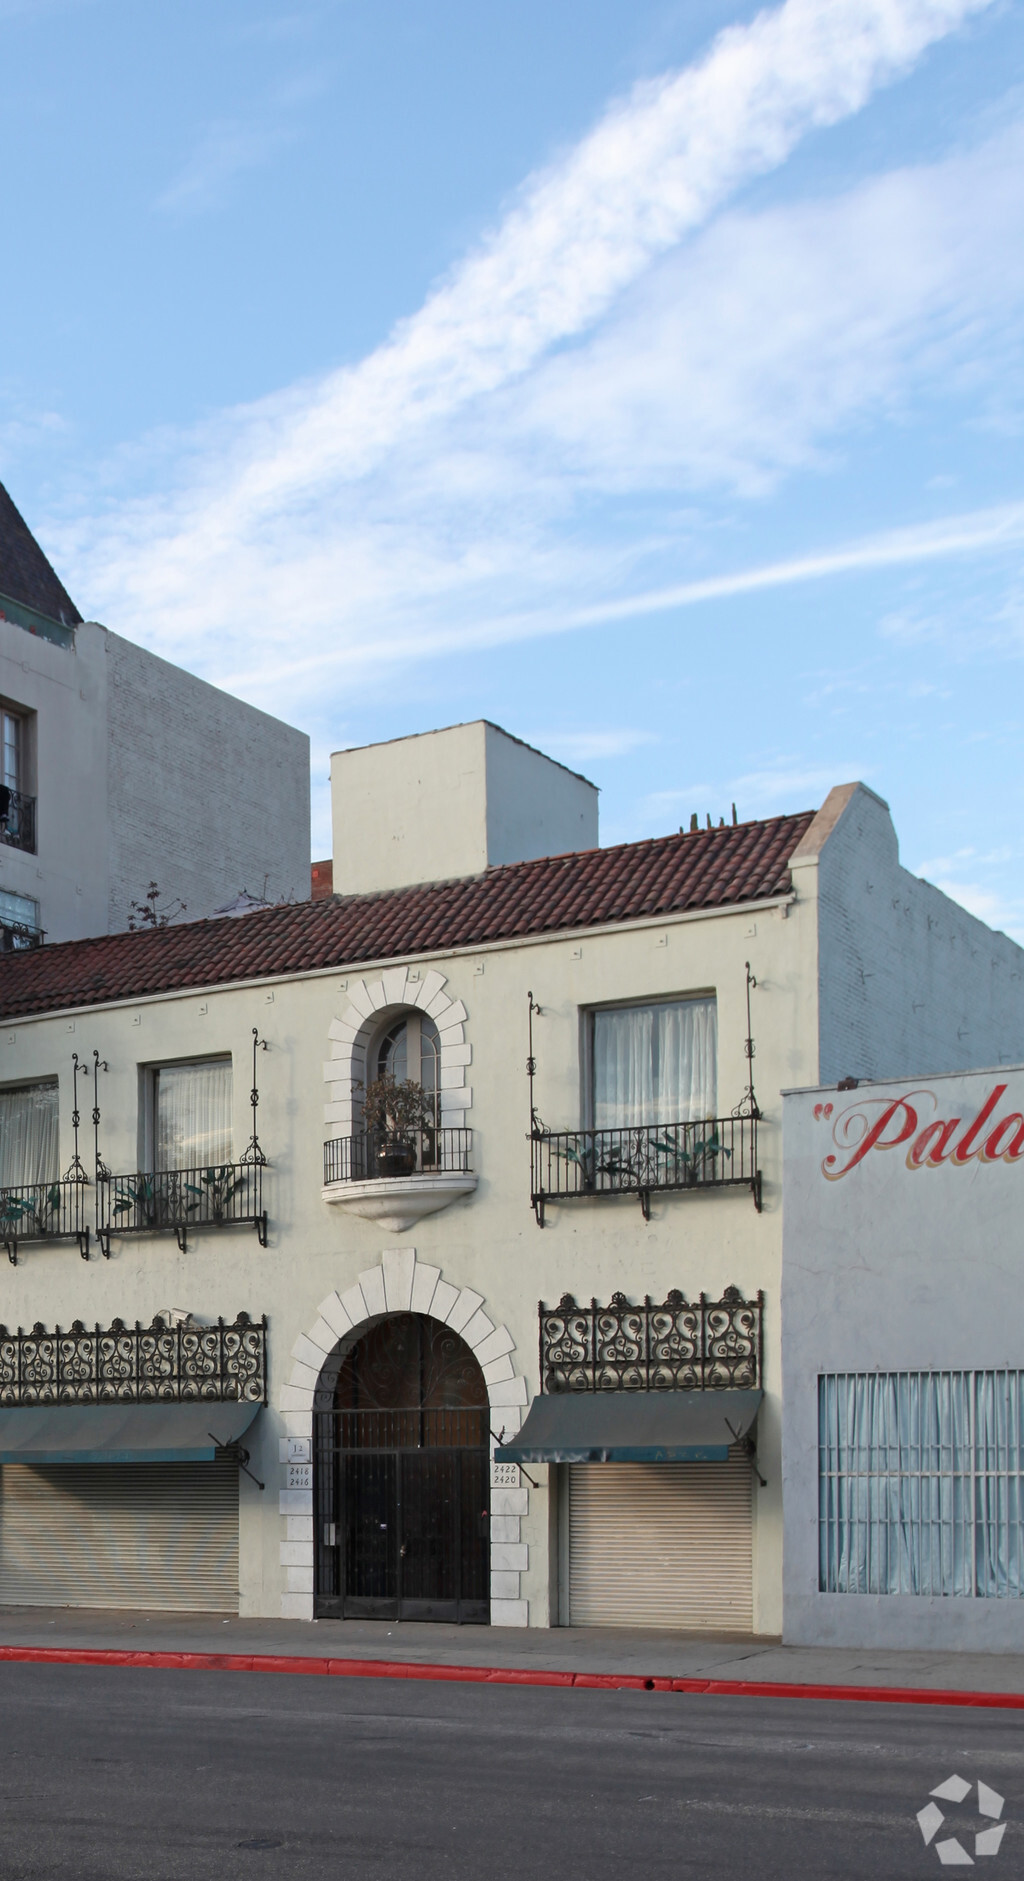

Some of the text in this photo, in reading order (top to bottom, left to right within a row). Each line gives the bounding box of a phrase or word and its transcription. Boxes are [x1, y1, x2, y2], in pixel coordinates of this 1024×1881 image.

[290, 1467, 309, 1475] 2418
[494, 1465, 516, 1473] 2422
[290, 1478, 309, 1486] 2416
[494, 1475, 516, 1484] 2420
